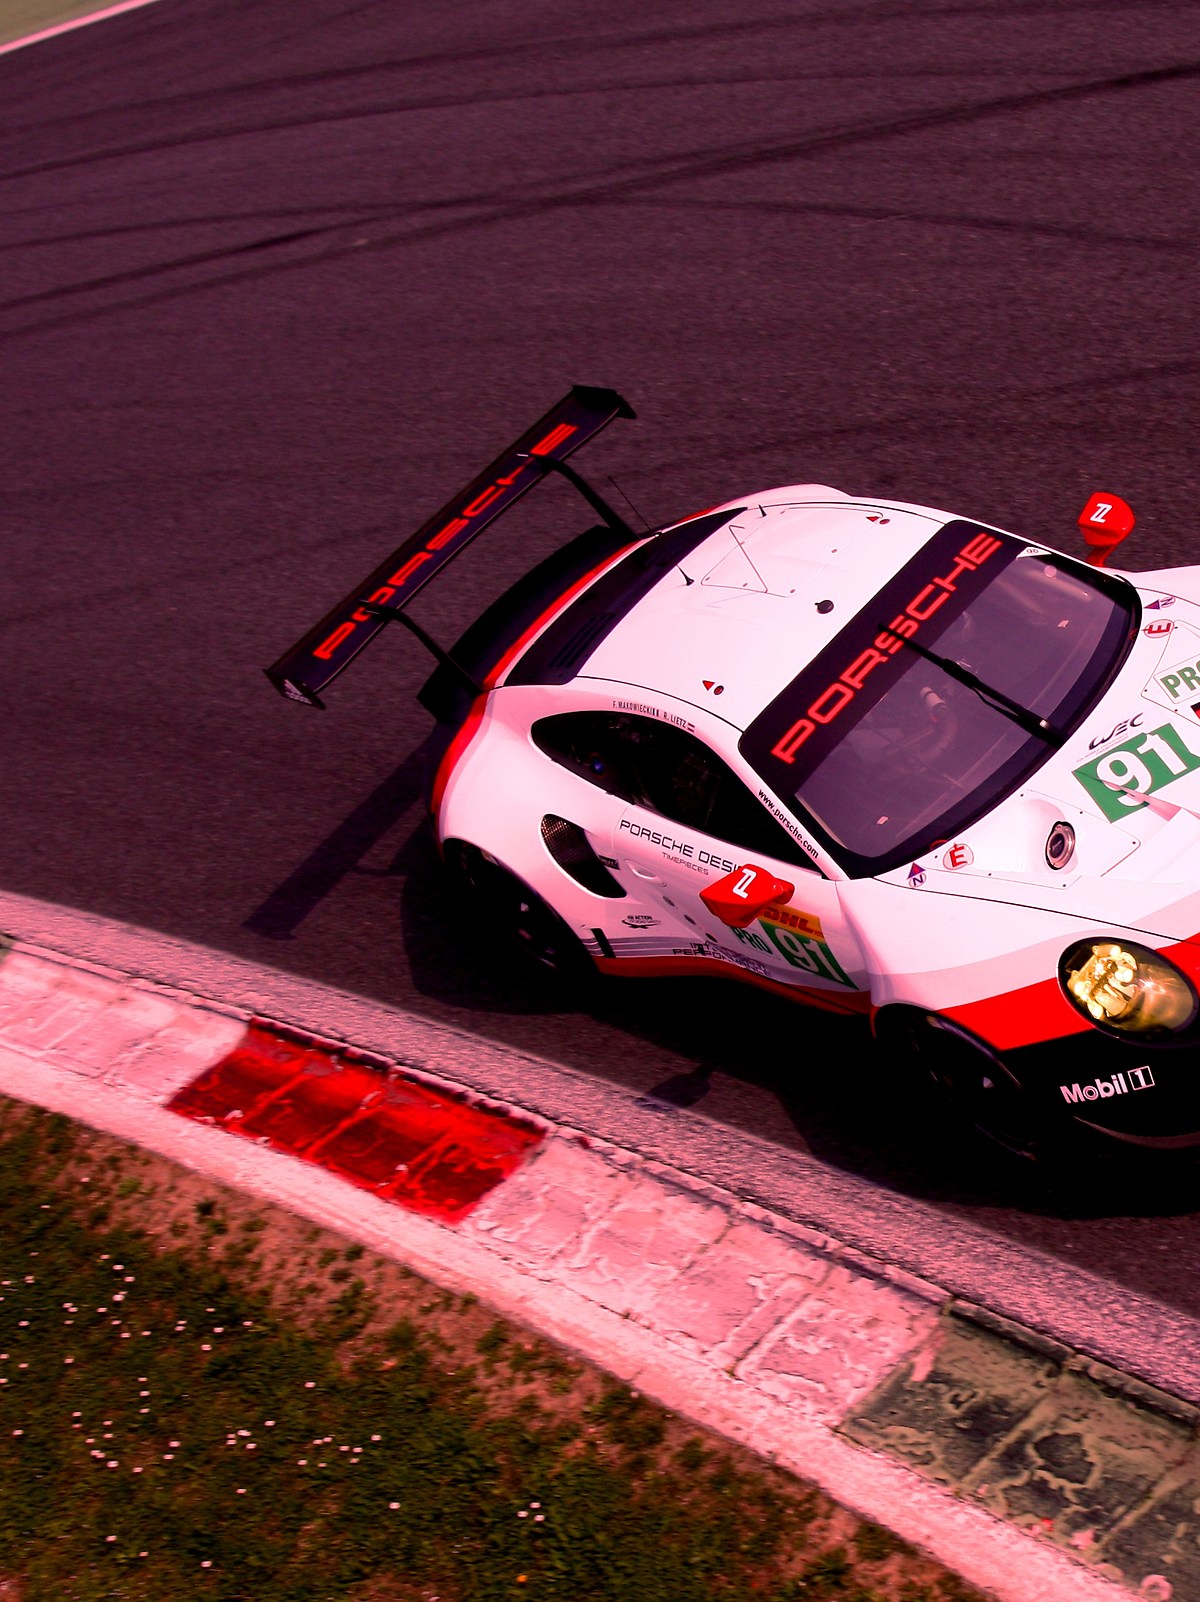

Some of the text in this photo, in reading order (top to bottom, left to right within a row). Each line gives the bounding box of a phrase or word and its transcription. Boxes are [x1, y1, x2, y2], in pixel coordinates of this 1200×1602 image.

[770, 532, 1003, 765] PORSCHE
[1096, 733, 1187, 807] 91
[619, 819, 743, 874] PORSCHE DESI
[758, 789, 819, 859] www.porsche.com
[661, 851, 709, 876] TIMEPIECES
[730, 926, 774, 956] PRO
[774, 927, 845, 984] 91
[1060, 1072, 1129, 1104] Mobil
